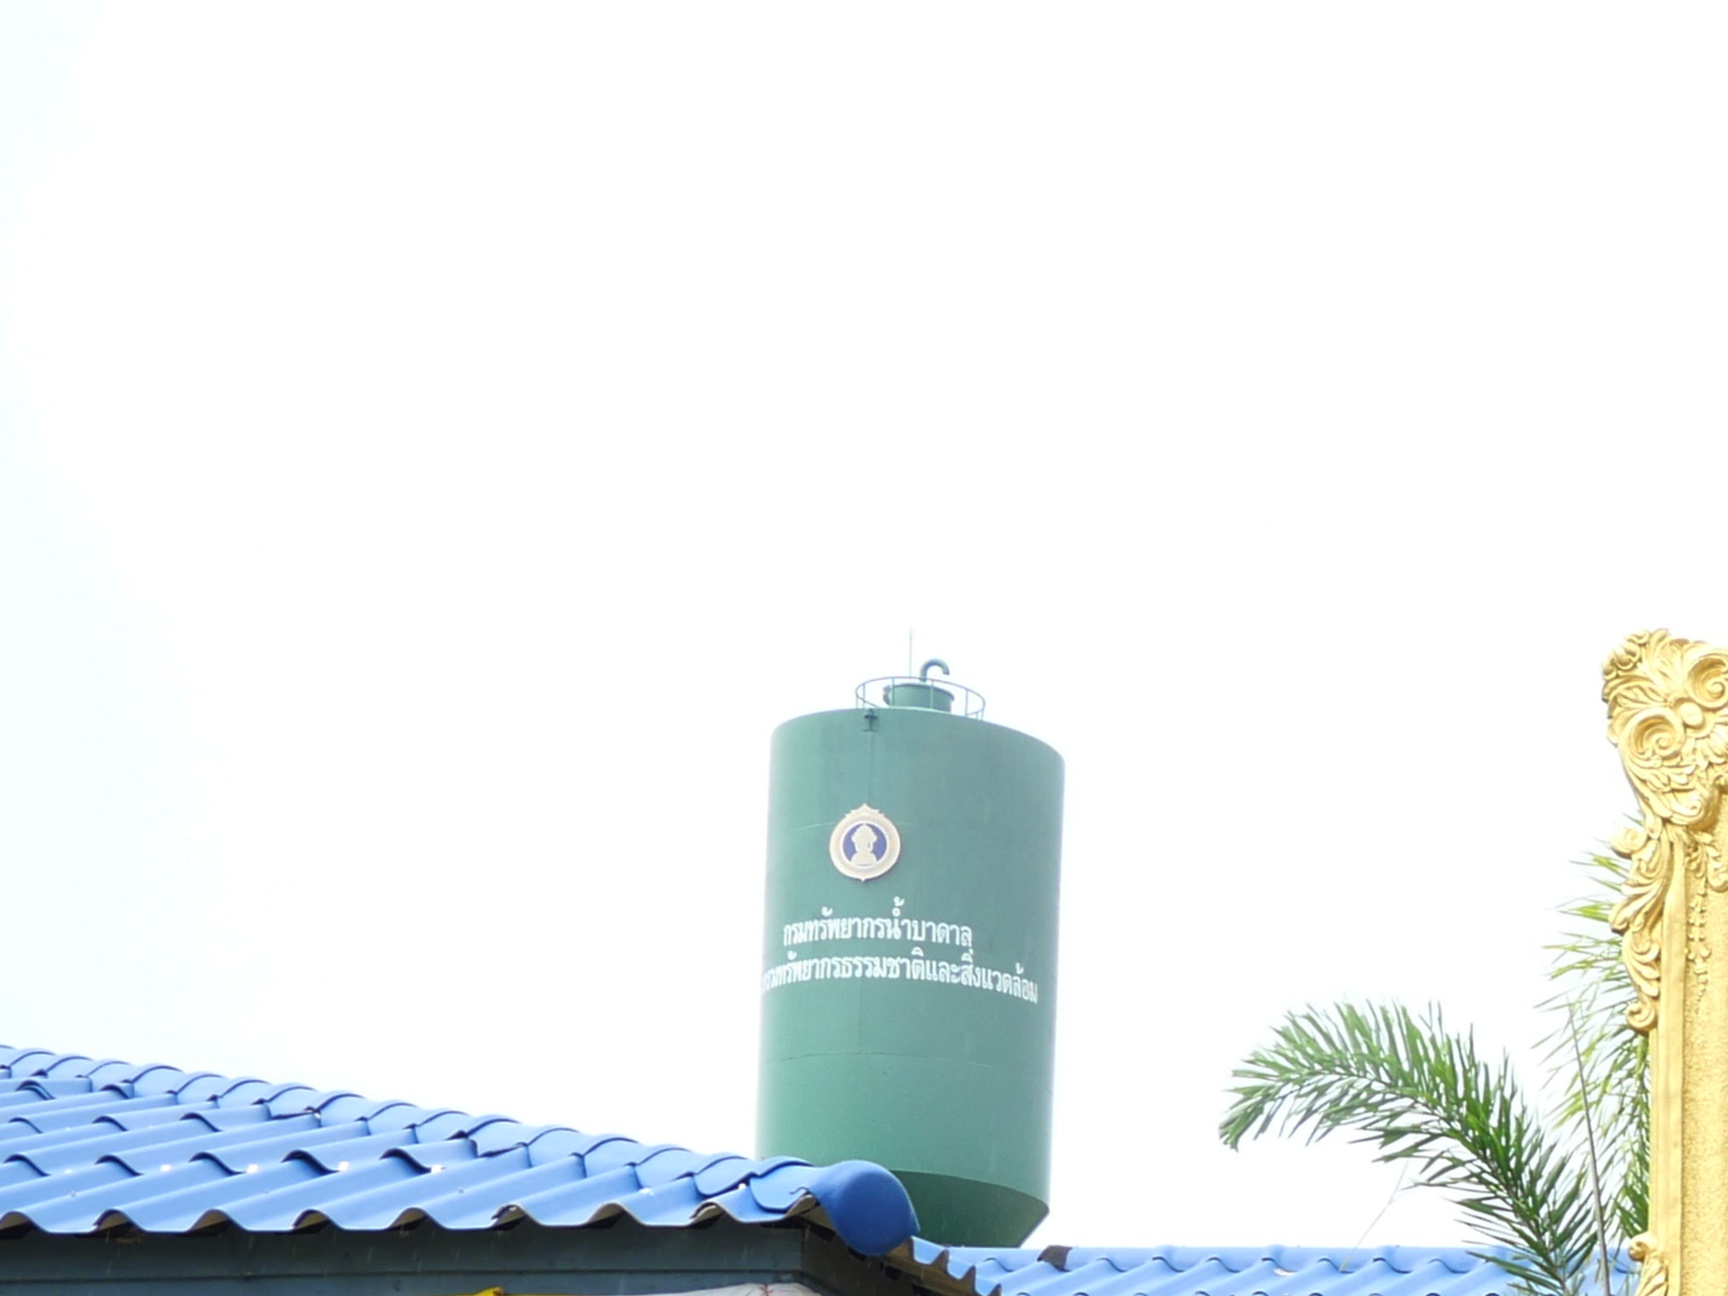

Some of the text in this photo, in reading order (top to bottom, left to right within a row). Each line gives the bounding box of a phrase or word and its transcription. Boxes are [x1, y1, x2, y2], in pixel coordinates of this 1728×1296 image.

[783, 896, 973, 948] กรมทรัพยากรน้ำบาดาล
